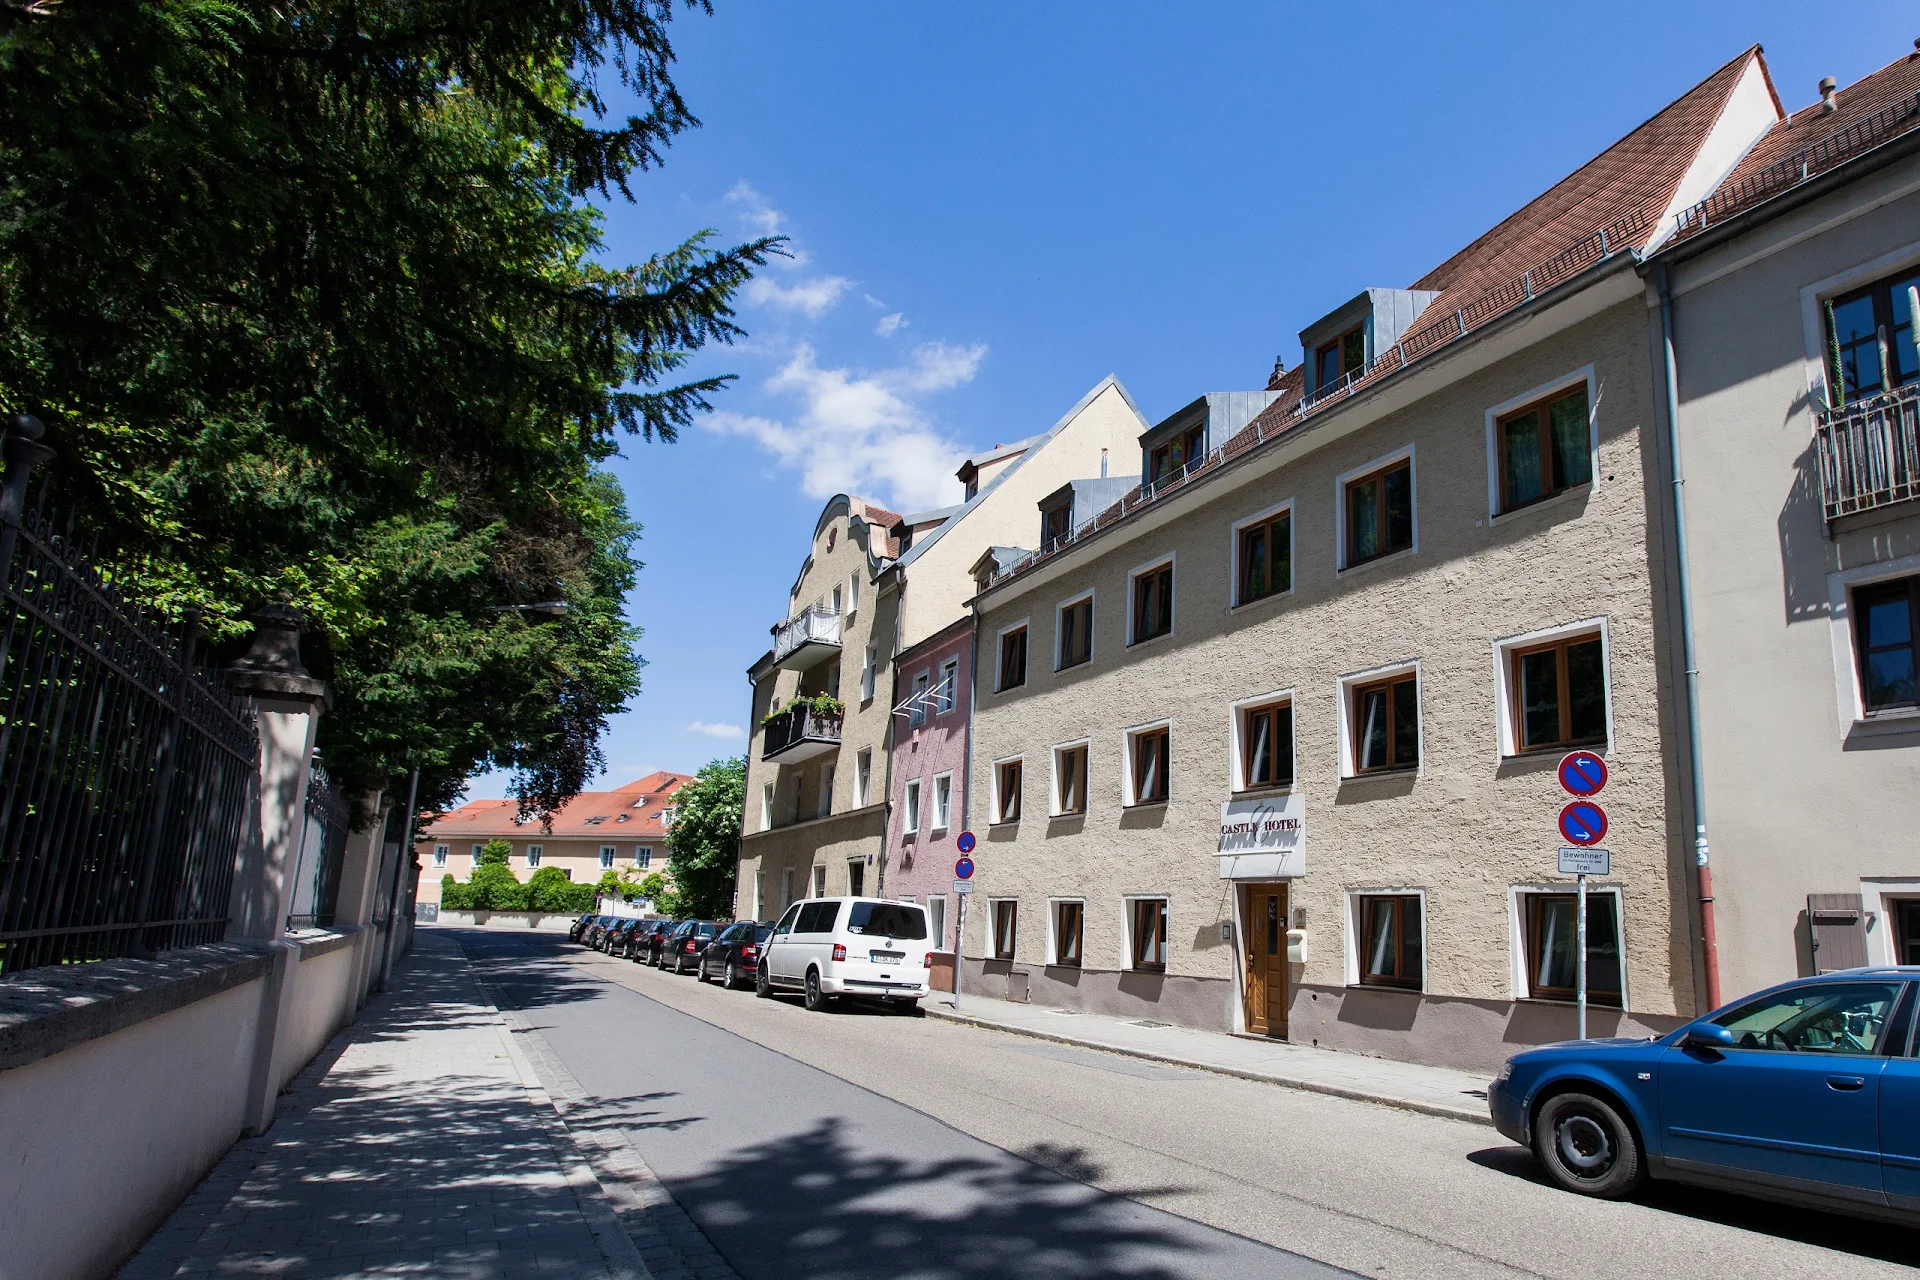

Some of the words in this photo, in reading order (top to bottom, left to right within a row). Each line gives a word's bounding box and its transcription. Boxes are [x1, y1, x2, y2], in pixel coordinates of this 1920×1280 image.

[1264, 818, 1301, 831] HOTEL
[1563, 851, 1603, 859] Bewohner
[1576, 863, 1590, 871] frei
